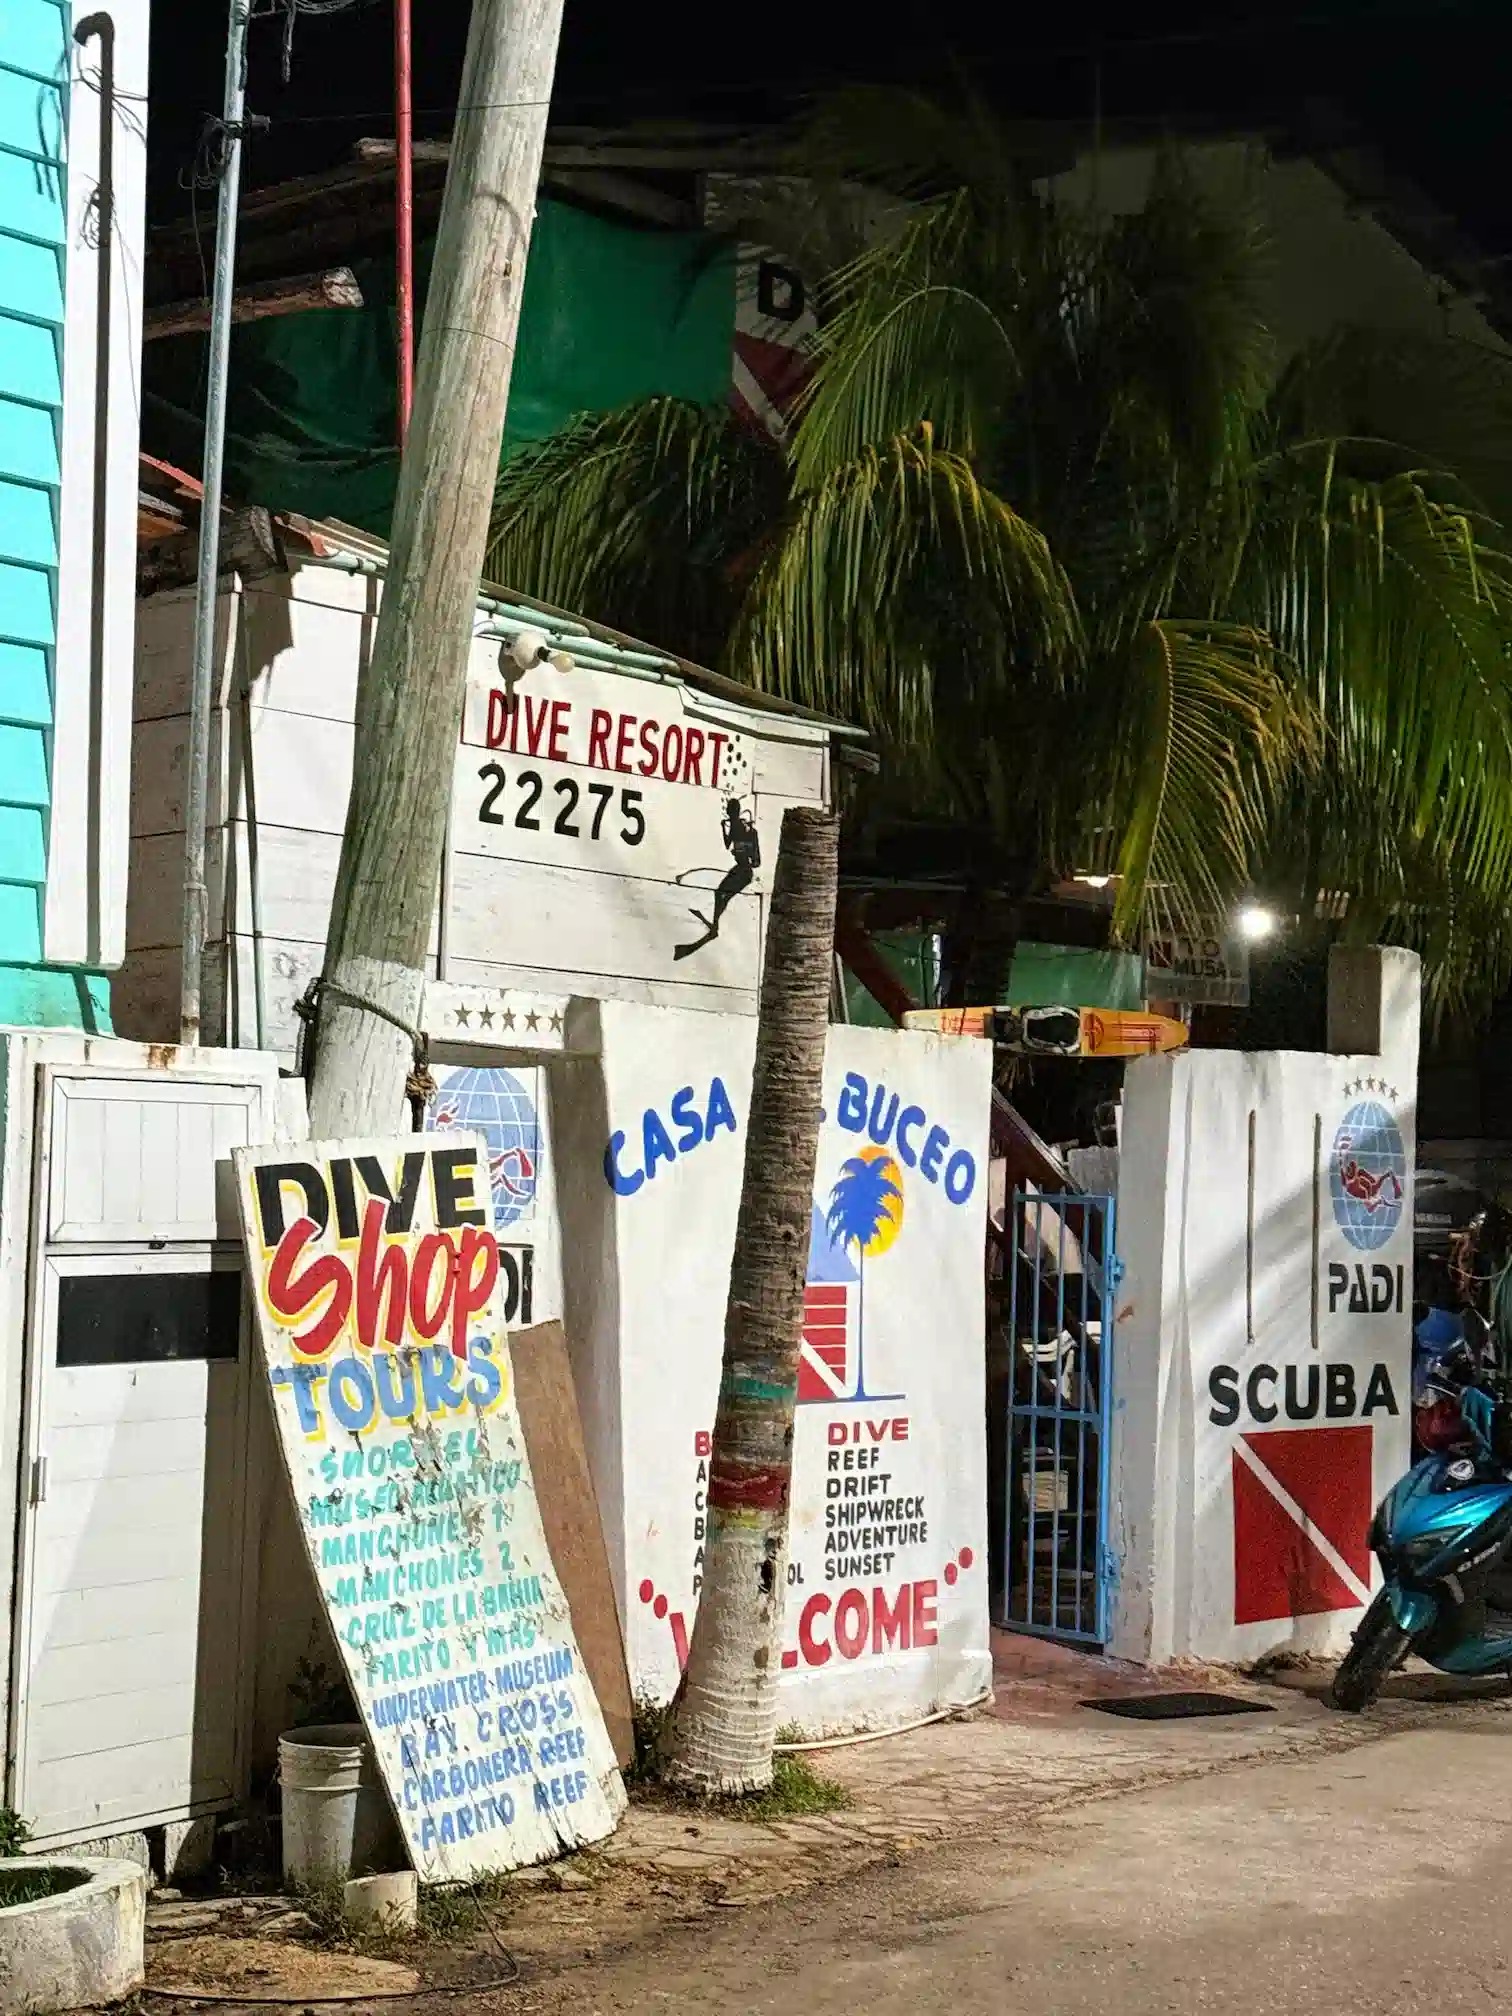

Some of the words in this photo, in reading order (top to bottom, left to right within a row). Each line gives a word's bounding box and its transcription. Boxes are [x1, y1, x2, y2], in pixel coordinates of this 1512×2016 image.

[487, 688, 571, 761] DIVE
[588, 708, 729, 788] RESORT
[477, 763, 646, 846] 22275
[603, 1076, 737, 1197] CASA
[837, 1071, 976, 1206] BUCEO
[255, 1148, 487, 1248] DIVE
[268, 1199, 499, 1361] Shop
[1328, 1262, 1404, 1314] PADI
[271, 1335, 502, 1434] TOURS
[1208, 1363, 1400, 1427] SCUBA
[320, 1428, 481, 1484] SNOREL
[828, 1418, 909, 1446] DIVE
[828, 1447, 880, 1471] REEF
[825, 1496, 925, 1528] SHIPWRECK
[826, 1473, 892, 1499] DRIFT
[322, 1508, 480, 1568] MANCHONE
[825, 1521, 928, 1554] ADVENTURE
[825, 1552, 895, 1581] SUNSET
[335, 1547, 485, 1608] MANCHONES
[498, 1541, 516, 1571] 2
[347, 1607, 417, 1650] CRUZ
[422, 1597, 449, 1629] DE
[452, 1590, 478, 1625] LA
[372, 1667, 490, 1729] UNDERWATER
[494, 1647, 574, 1696] MUSEUM
[401, 1719, 458, 1769] BAY
[477, 1689, 574, 1743] CROSS
[402, 1743, 533, 1812] CARBONERA
[538, 1725, 586, 1769] REEF
[533, 1769, 589, 1813] REEF
